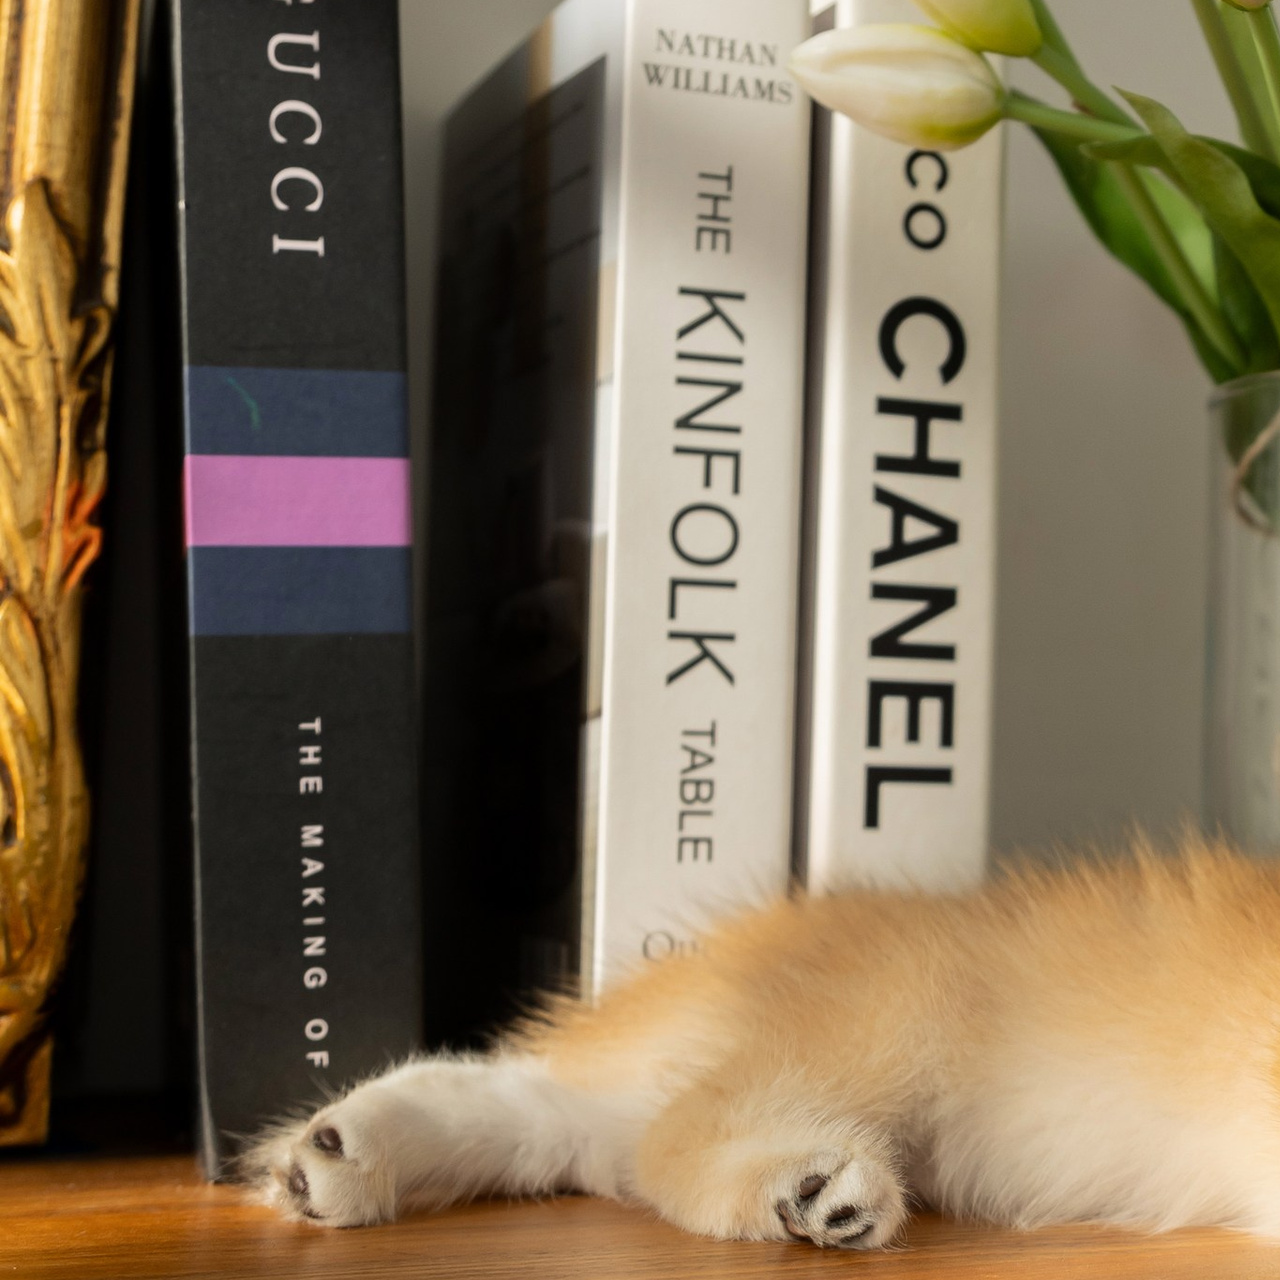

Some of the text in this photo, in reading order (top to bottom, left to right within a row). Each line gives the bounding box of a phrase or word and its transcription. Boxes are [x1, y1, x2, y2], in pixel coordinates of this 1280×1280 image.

[641, 62, 794, 104] WILLIAMS
[656, 28, 777, 67] NATHAN
[666, 165, 746, 863] THE KINFOLK TABLE
[863, 148, 967, 830] CO CHANEL
[298, 717, 330, 1069] THE MAKING OF
